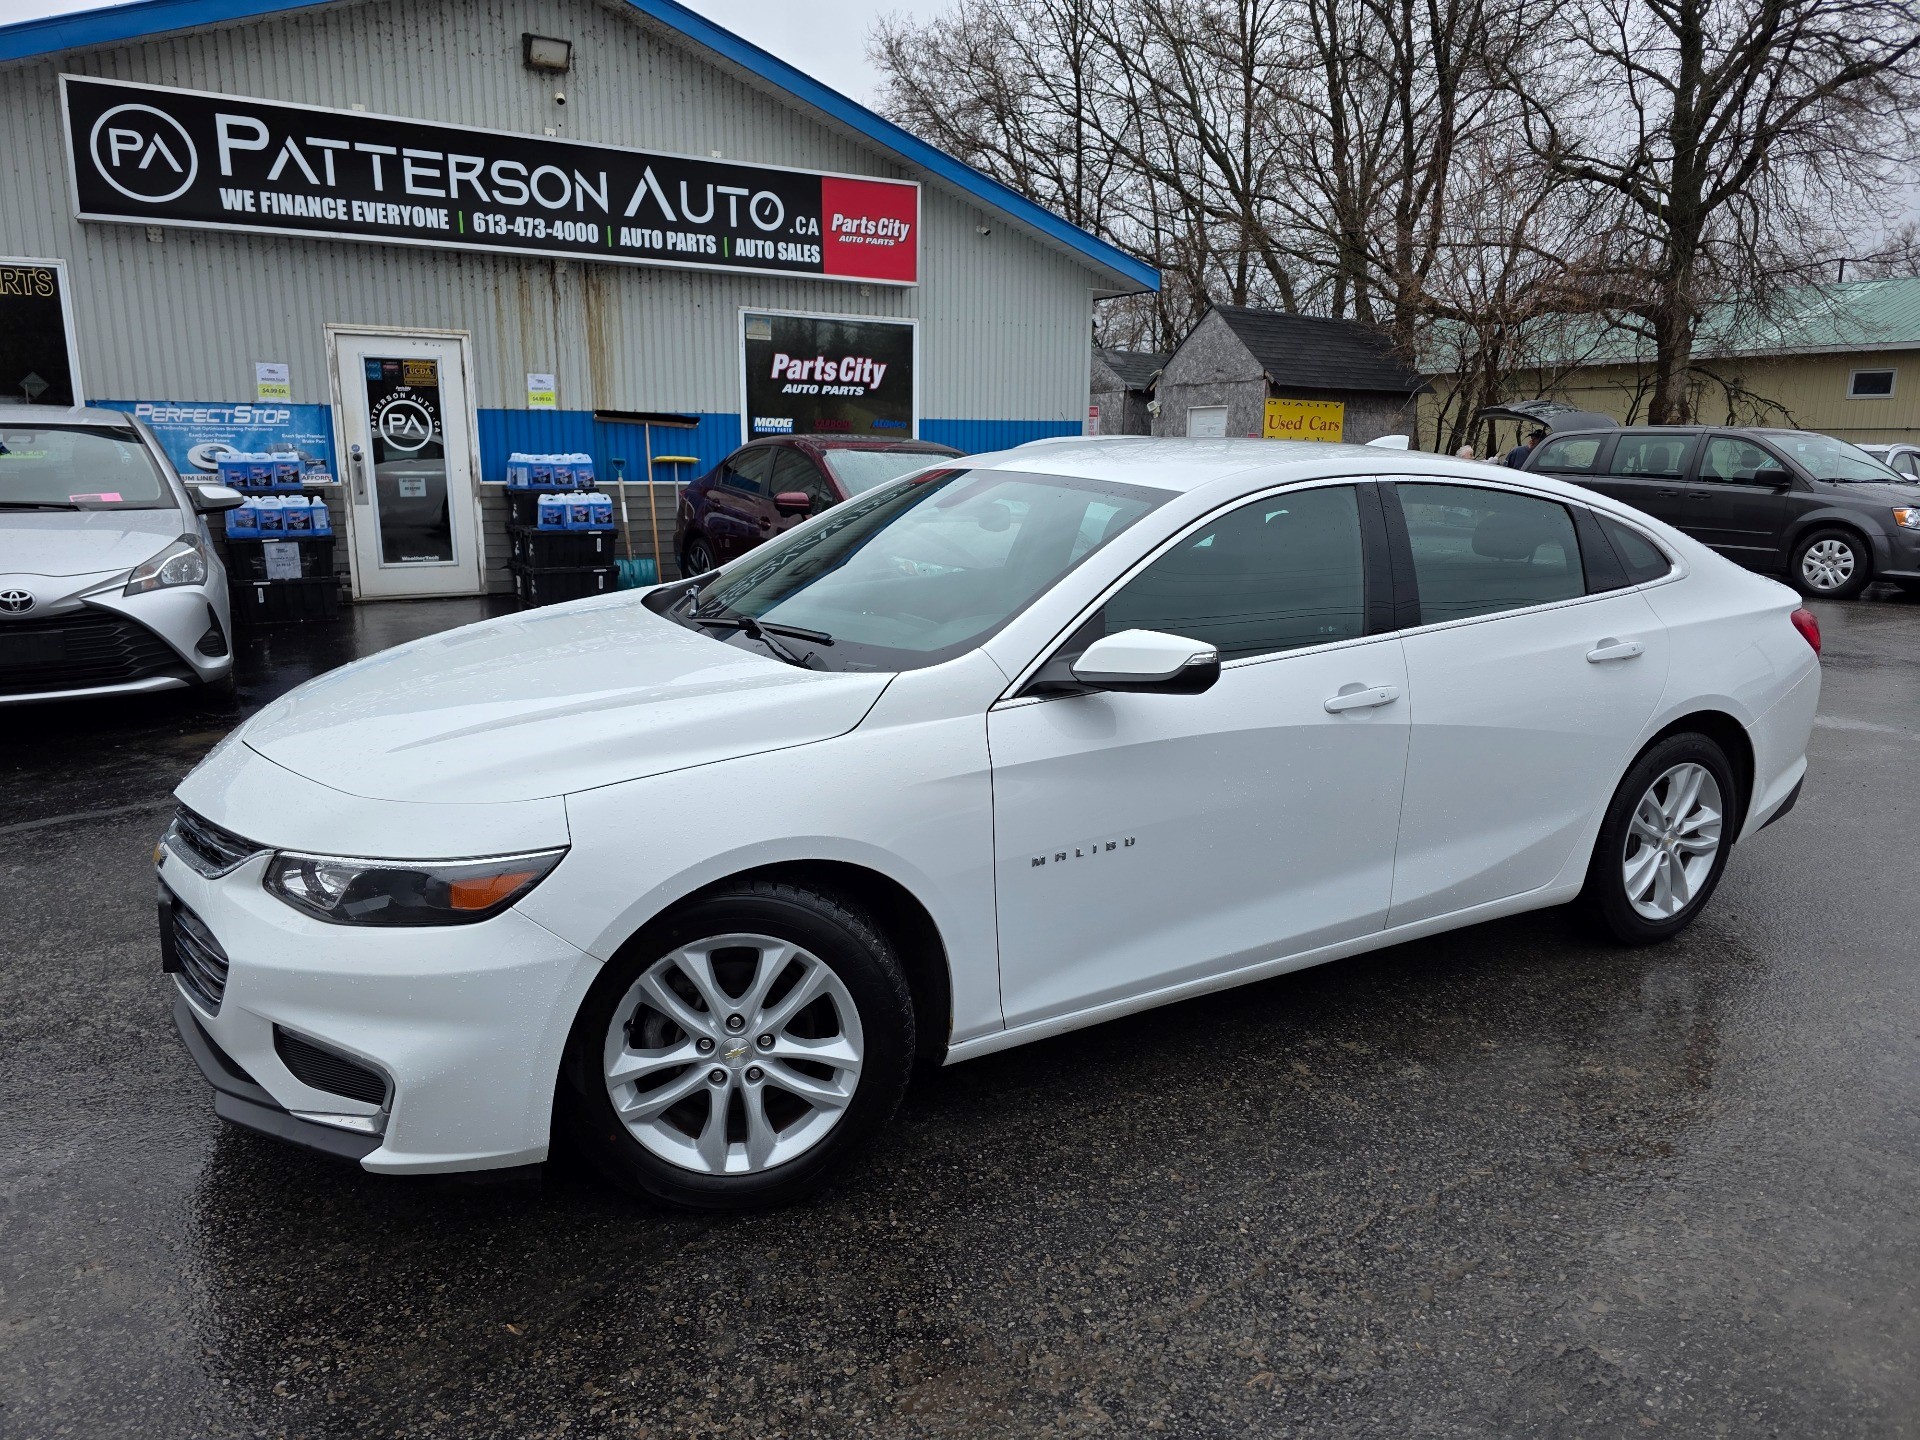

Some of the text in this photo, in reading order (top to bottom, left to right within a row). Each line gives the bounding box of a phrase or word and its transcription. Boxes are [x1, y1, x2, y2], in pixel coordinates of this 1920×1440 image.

[108, 127, 184, 174] PA
[215, 113, 820, 236] PATTERSON AUTO .CA
[219, 188, 821, 264] WE FINANCE EVERYONE 613-473-4000 AUTO PARTS AUTO SALES
[838, 235, 895, 246] AUTO PARTS
[0, 267, 54, 297] RTS
[782, 383, 865, 396] AUTO PARTS
[371, 392, 406, 432] PATTERSON
[411, 394, 434, 413] AUTO
[1268, 401, 1341, 409] QUALITY
[388, 413, 425, 434] PA
[754, 417, 793, 427] MOOG
[1269, 414, 1340, 431] Used Cars
[1032, 836, 1136, 868] MALIBU
